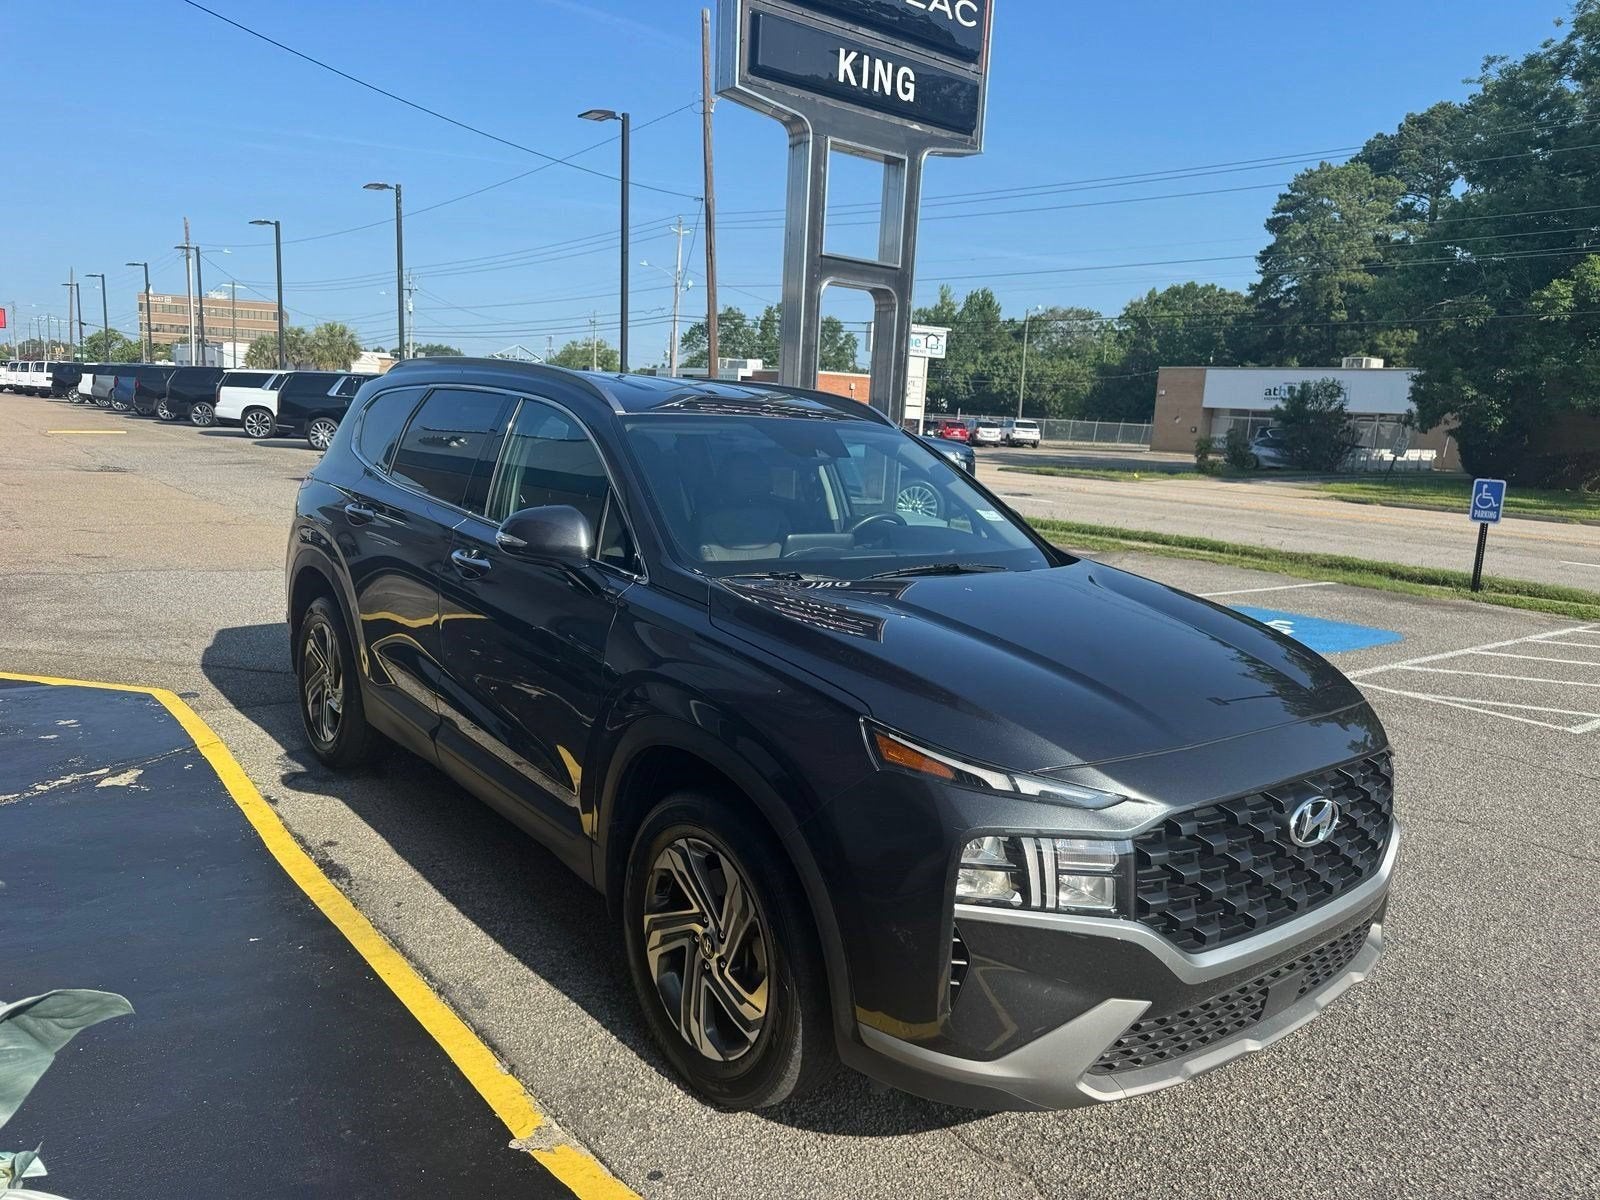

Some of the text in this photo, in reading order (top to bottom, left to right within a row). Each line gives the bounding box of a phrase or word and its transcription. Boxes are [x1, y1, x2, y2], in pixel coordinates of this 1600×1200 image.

[905, 0, 978, 27] AC
[838, 48, 916, 102] KING
[1474, 509, 1497, 519] PARKING
